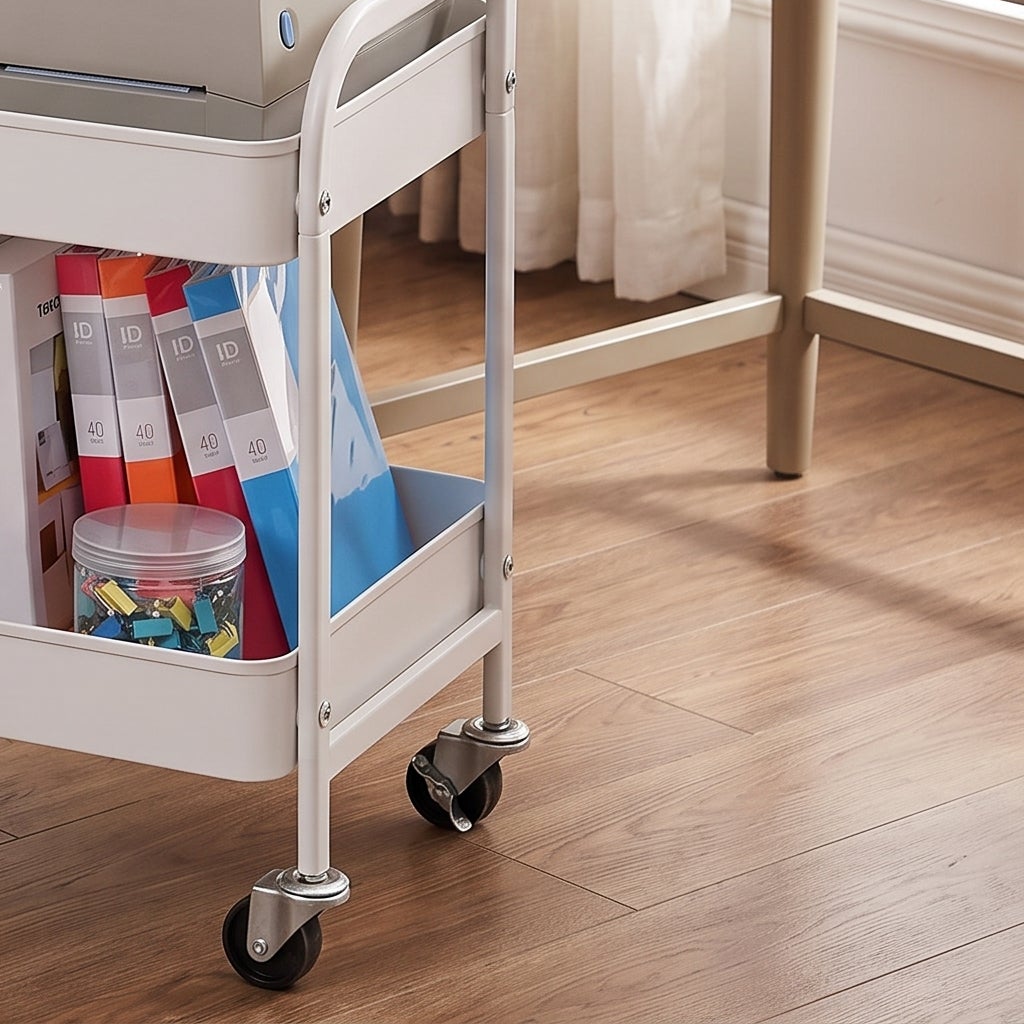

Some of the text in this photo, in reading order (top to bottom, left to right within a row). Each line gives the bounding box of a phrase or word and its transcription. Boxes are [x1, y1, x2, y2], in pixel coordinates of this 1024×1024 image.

[87, 421, 104, 438] 40
[136, 423, 154, 440] 40
[200, 433, 219, 451] 40
[248, 438, 267, 457] 40
